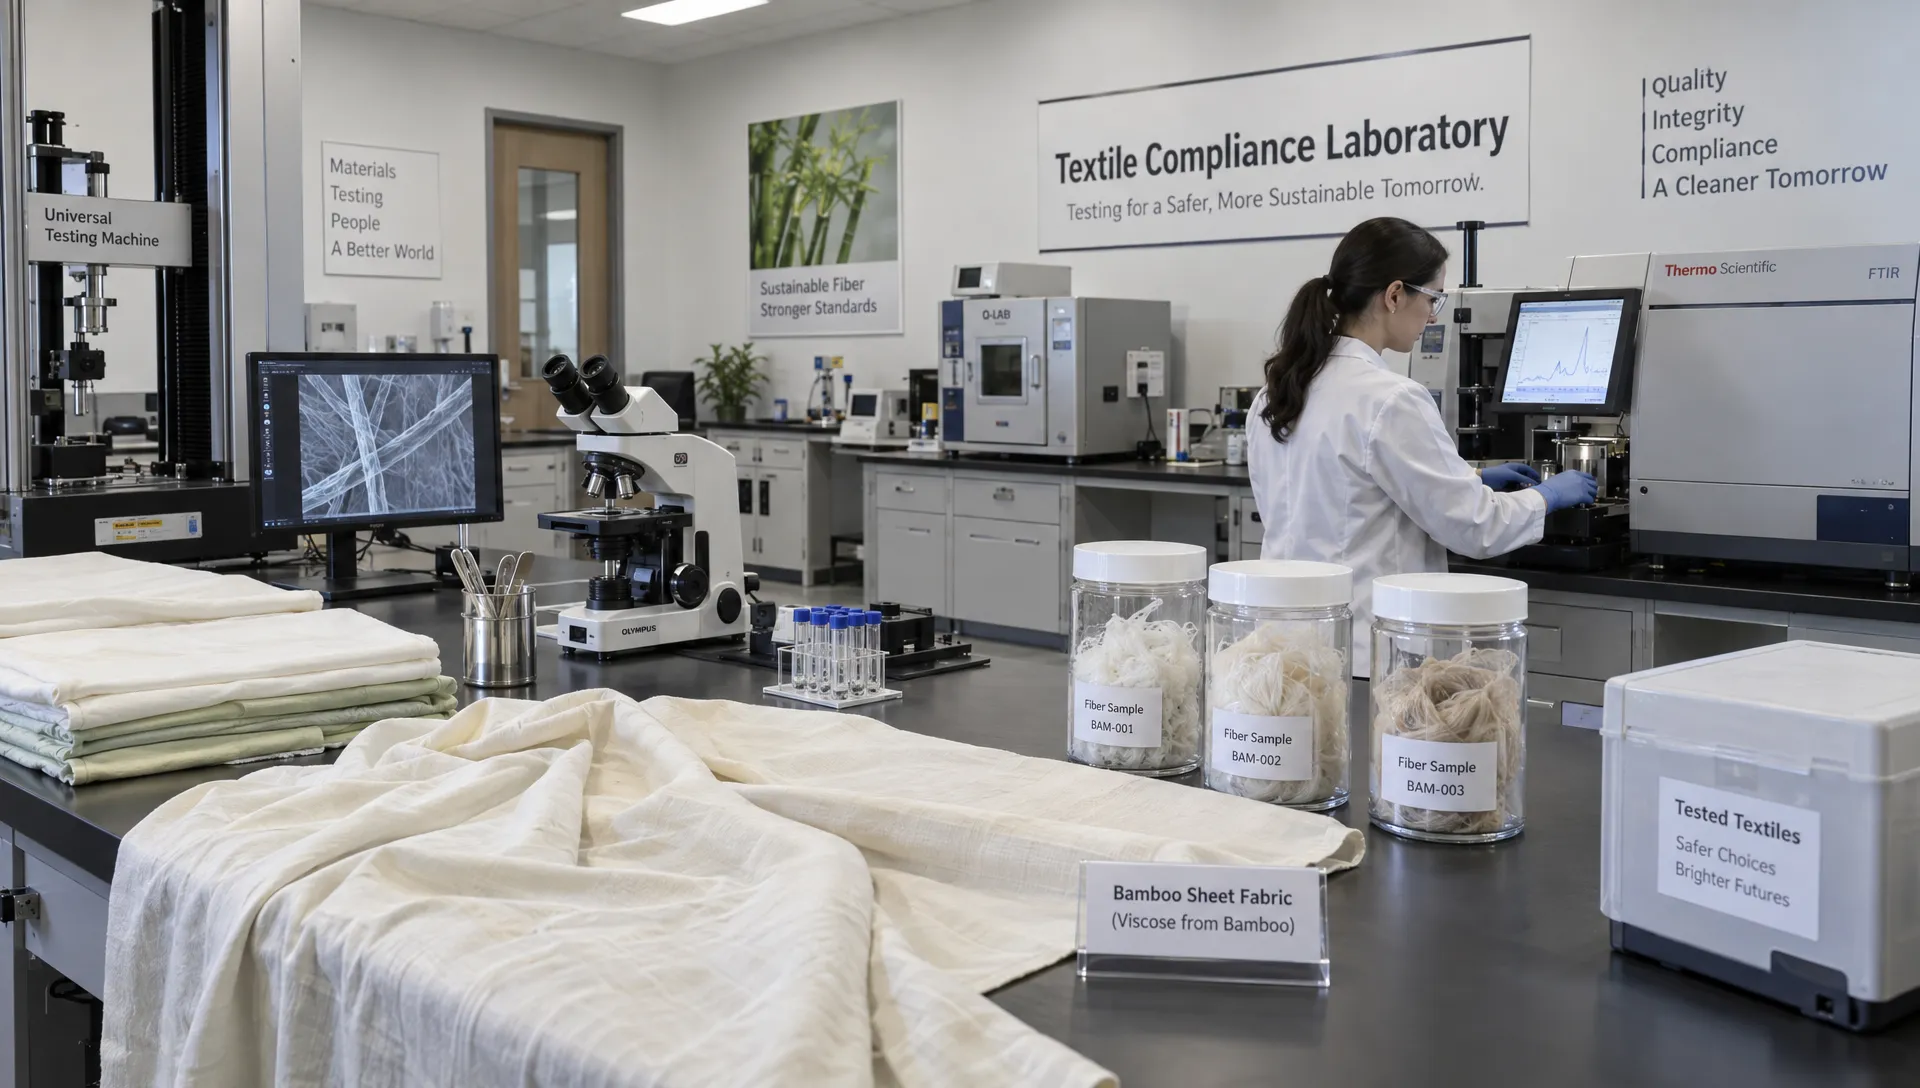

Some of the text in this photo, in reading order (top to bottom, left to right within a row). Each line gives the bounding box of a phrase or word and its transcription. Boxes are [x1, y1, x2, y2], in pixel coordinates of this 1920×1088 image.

[1652, 67, 1728, 99] Quality
[1653, 102, 1745, 132] Integrity
[1054, 114, 1510, 185] Textile Compliance Laboratory
[1651, 137, 1778, 166] Compliance
[330, 157, 397, 180] Materials
[1652, 163, 1888, 198] A Cleaner Tomorrow
[330, 184, 384, 209] Testing
[1066, 172, 1484, 223] Testing for a Safer, More Sustainable Tomorrow.
[44, 207, 112, 226] Universal
[331, 212, 381, 234] People
[44, 227, 160, 248] Testing Machine
[330, 240, 435, 261] A Better World
[1664, 260, 1777, 277] Thermo Scientific
[1868, 266, 1900, 280] FTIR
[760, 276, 865, 296] Sustainable Fiber
[760, 297, 878, 320] Stronger Standards
[621, 625, 657, 636] OLYMPUS
[1084, 698, 1144, 717] Fiber Sample
[1091, 719, 1134, 734] BAM-001
[1224, 727, 1293, 747] Fiber Sample
[1232, 750, 1282, 767] BAM-002
[1398, 756, 1477, 777] Fiber Sample
[1407, 779, 1465, 797] BAM-003
[1674, 798, 1801, 845] Tested Textiles
[1676, 835, 1777, 876] Safer Choices
[1113, 884, 1293, 906] Bamboo Sheet Fabric
[1675, 860, 1791, 908] Brighter Futures
[1111, 911, 1295, 937] (Viscose from Bamboo)
